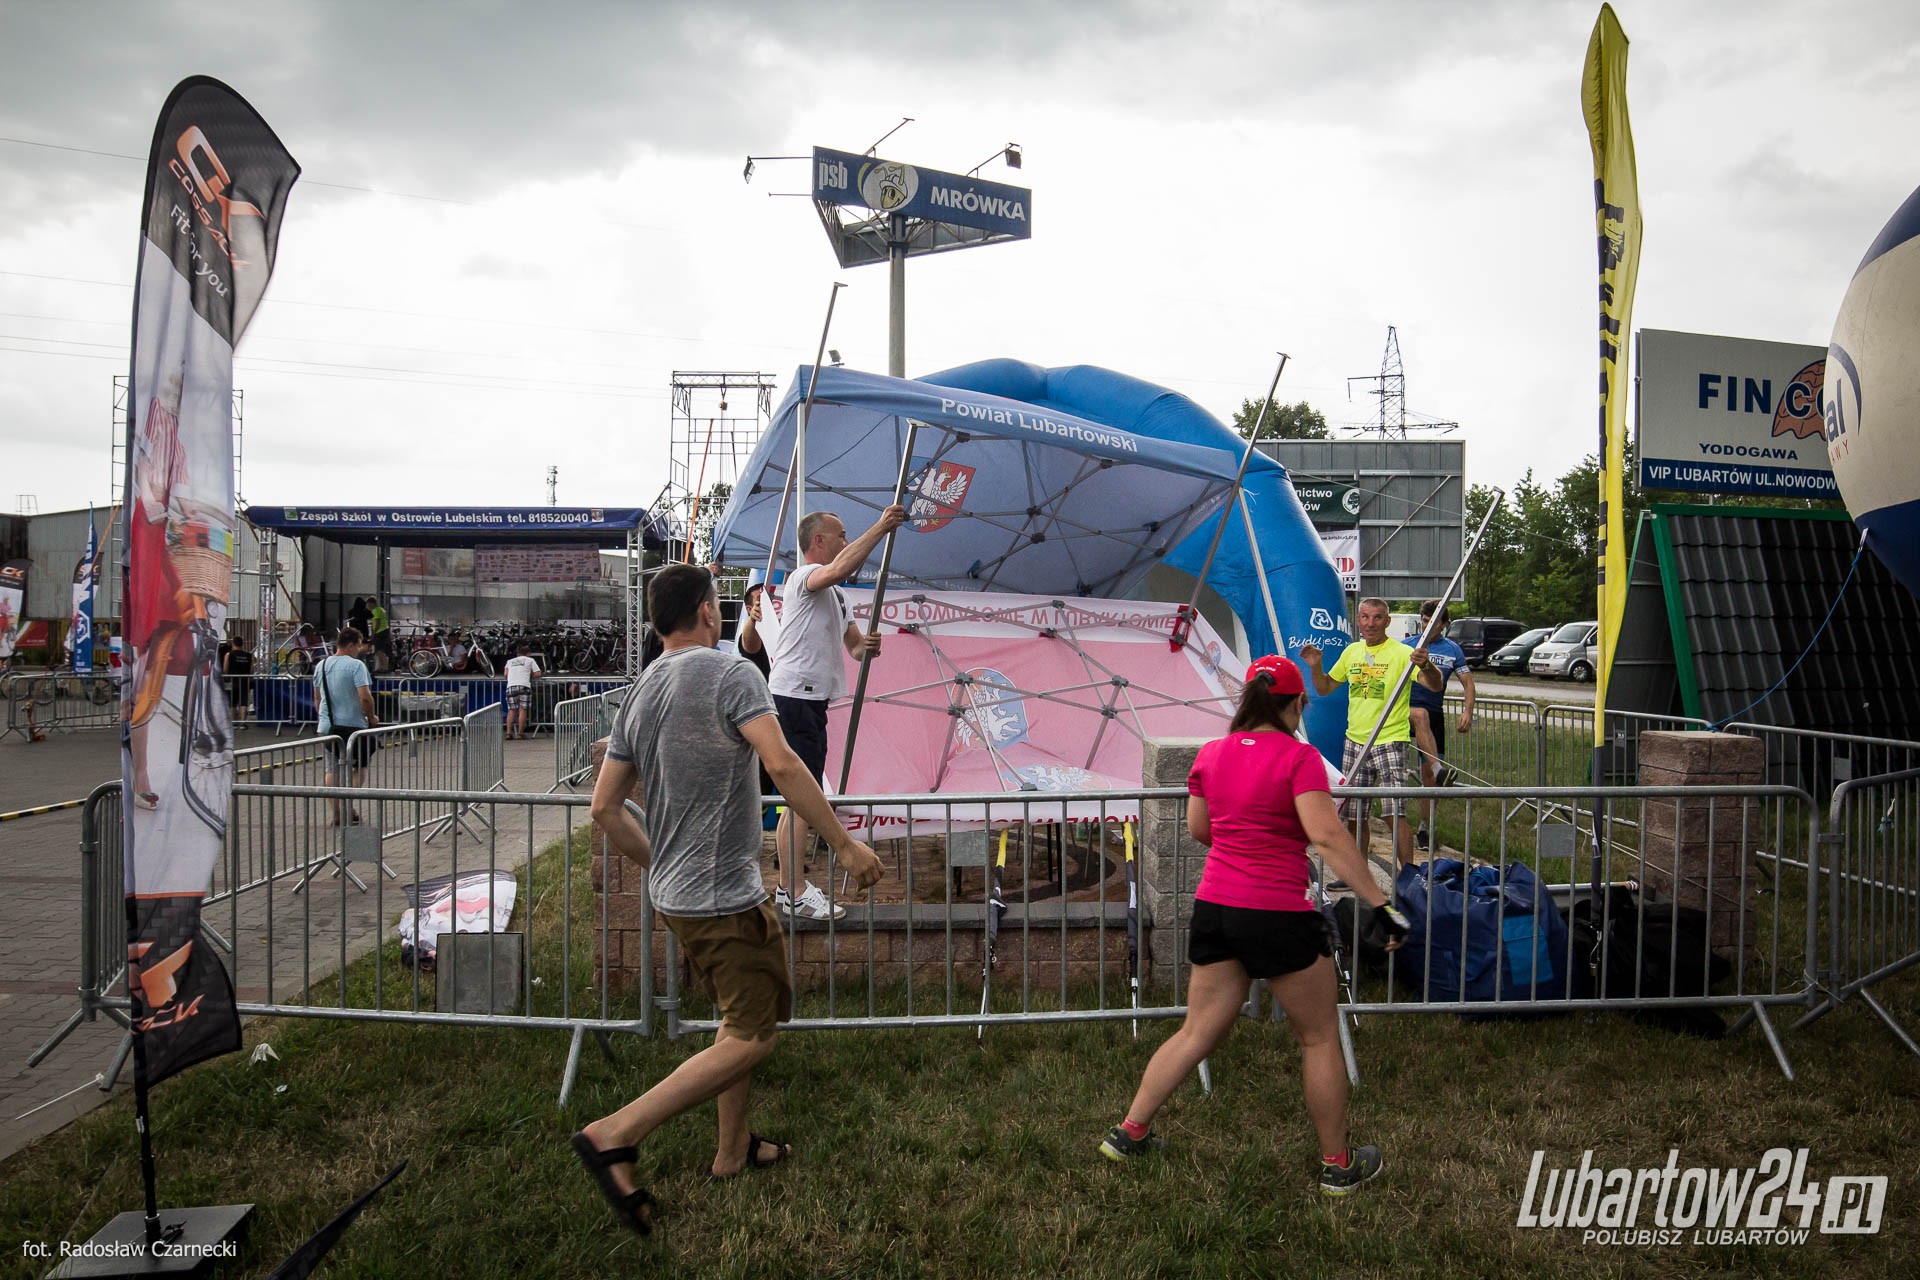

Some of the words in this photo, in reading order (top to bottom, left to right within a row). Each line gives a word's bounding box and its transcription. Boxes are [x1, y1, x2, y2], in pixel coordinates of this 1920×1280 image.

[818, 161, 848, 191] psb
[930, 186, 1026, 222] MRÓWKA
[170, 203, 192, 235] Fit
[195, 262, 229, 298] you
[941, 399, 1014, 426] Powiat
[1018, 412, 1139, 453] Lubartowski
[1698, 443, 1799, 461] YODOGAWA
[1649, 465, 1672, 480] VIP
[1674, 467, 1752, 485] LUBARTÓW
[1755, 473, 1837, 490] UL.NOWODW
[1295, 487, 1333, 498] nictwo
[377, 513, 387, 522] w
[391, 512, 442, 523] Ostrowie
[445, 512, 503, 523] Lubelskim
[506, 513, 526, 523] tel.
[528, 513, 589, 523] 818520040
